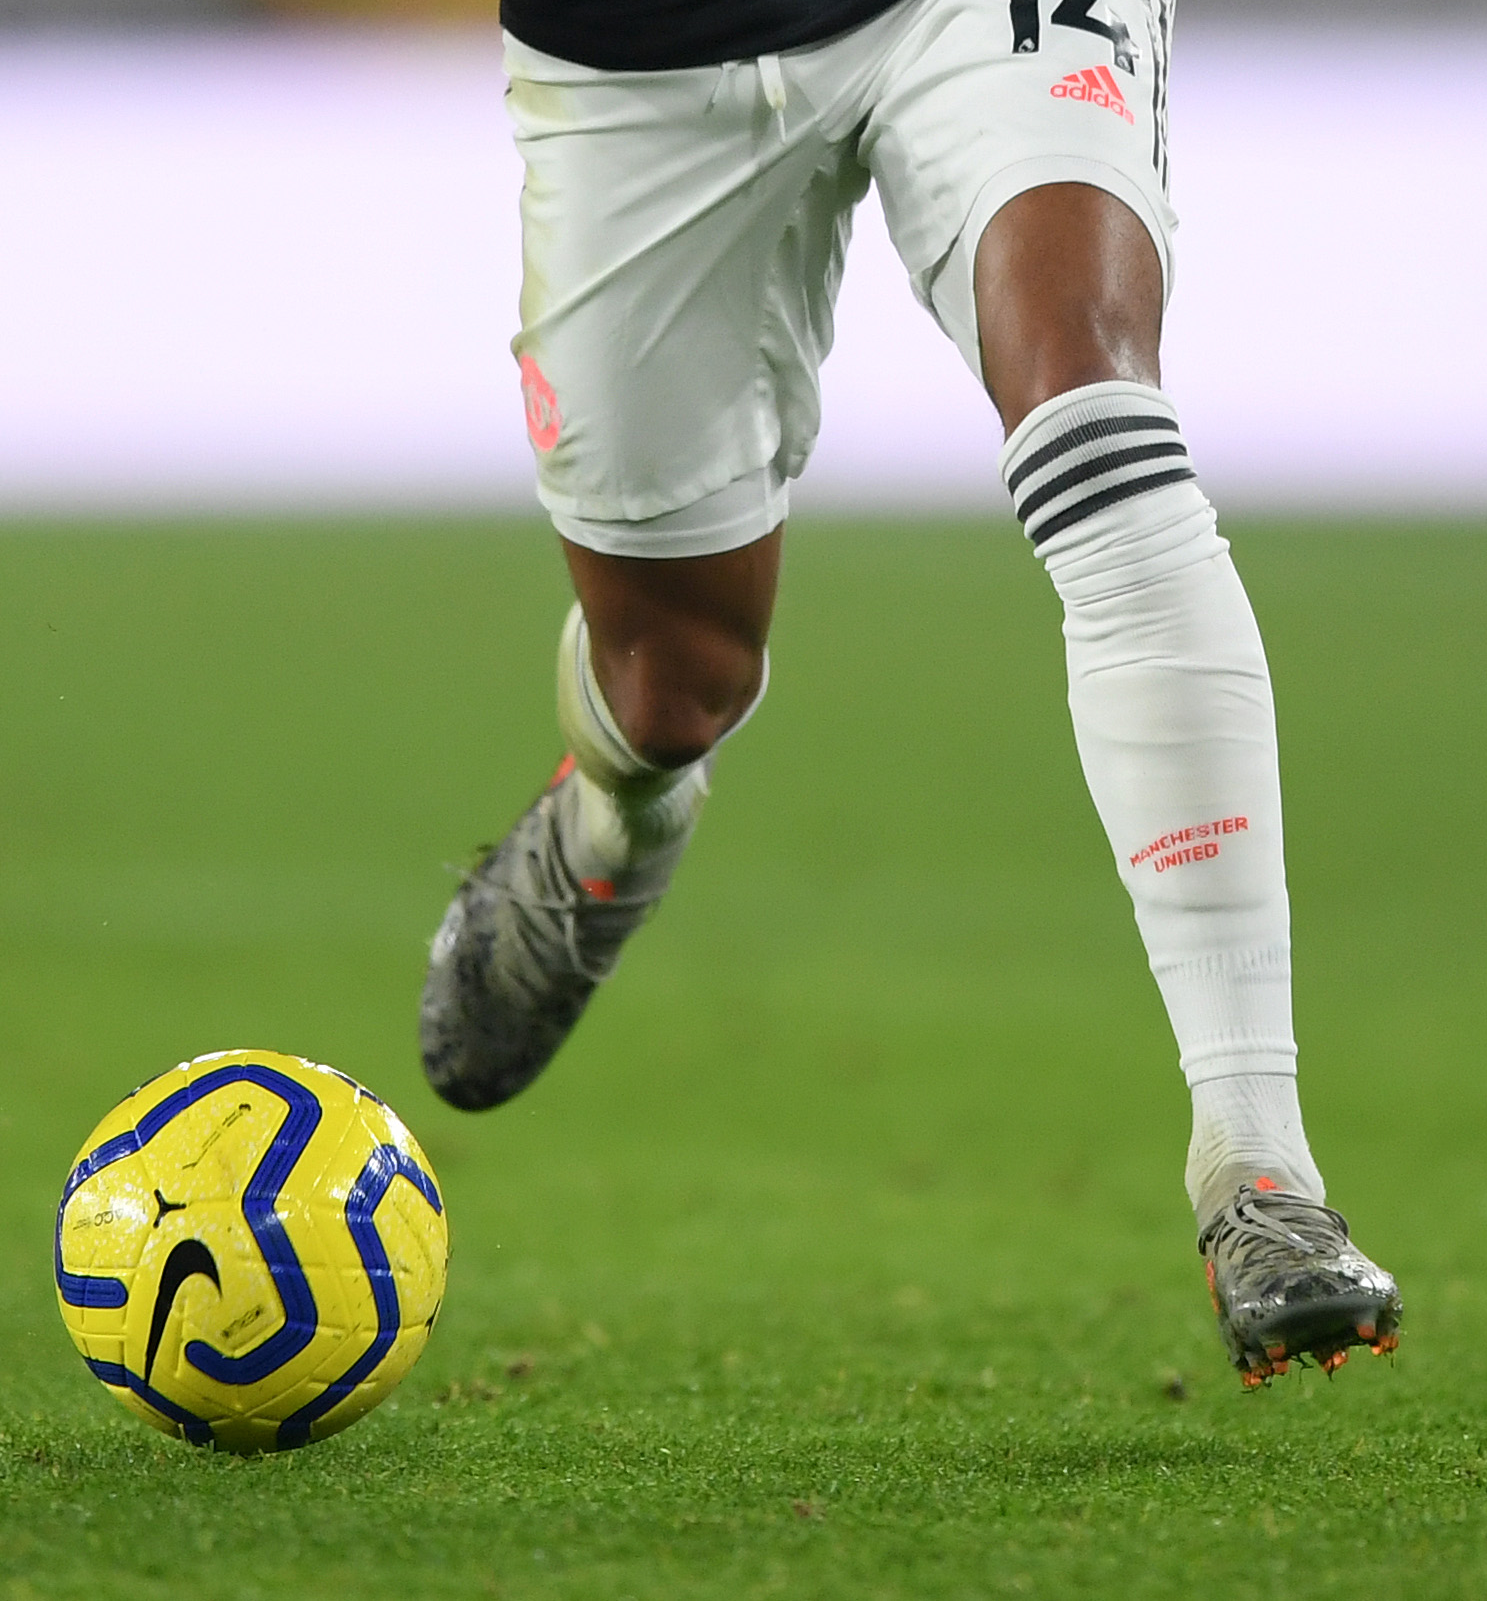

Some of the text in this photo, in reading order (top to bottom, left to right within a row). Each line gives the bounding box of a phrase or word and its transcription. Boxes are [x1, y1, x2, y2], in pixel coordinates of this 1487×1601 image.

[1049, 85, 1135, 125] adidas
[1129, 816, 1249, 868] MANCHESTER
[1153, 841, 1220, 873] UNITED
